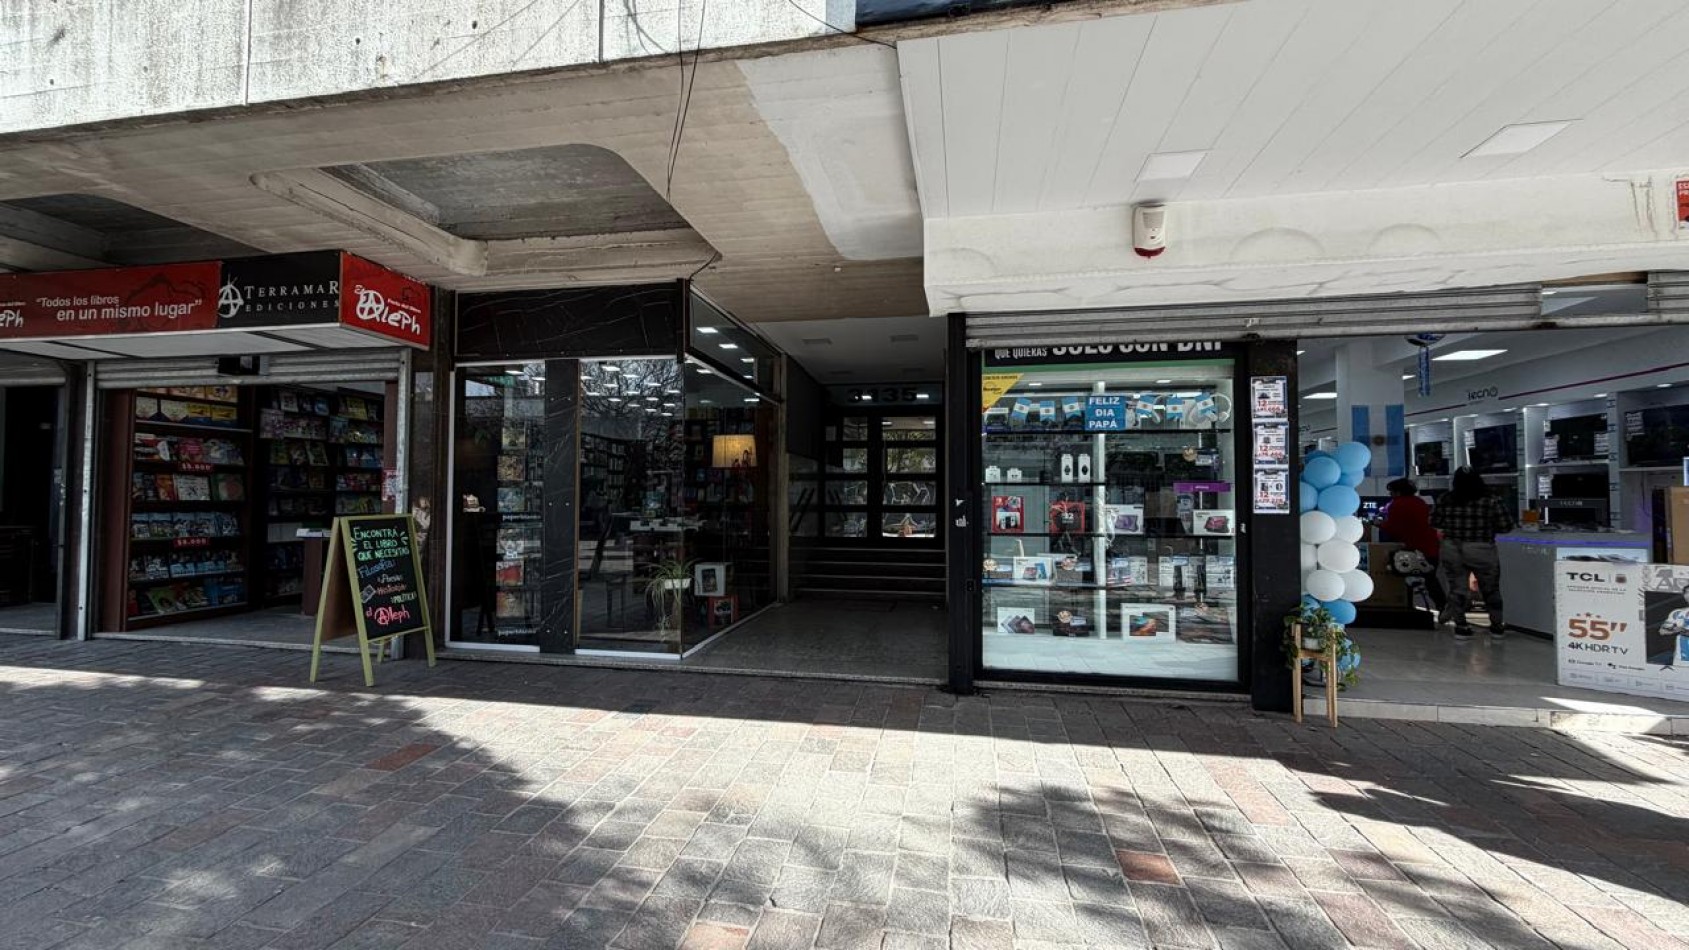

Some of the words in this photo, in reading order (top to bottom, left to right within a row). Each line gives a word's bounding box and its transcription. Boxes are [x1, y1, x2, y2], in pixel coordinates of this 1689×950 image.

[244, 281, 339, 299] TERRAMAR
[73, 296, 88, 306] los
[90, 295, 120, 305] libros
[245, 300, 339, 312] EDICIONES
[57, 309, 74, 321] en
[79, 308, 97, 320] un
[101, 305, 150, 319] mismo
[1089, 396, 1120, 405] FELIZ
[1094, 408, 1115, 417] DIA
[363, 541, 373, 549] EL
[376, 539, 398, 549] LIBRO
[358, 550, 373, 561] QUE
[1565, 572, 1606, 583] TCL
